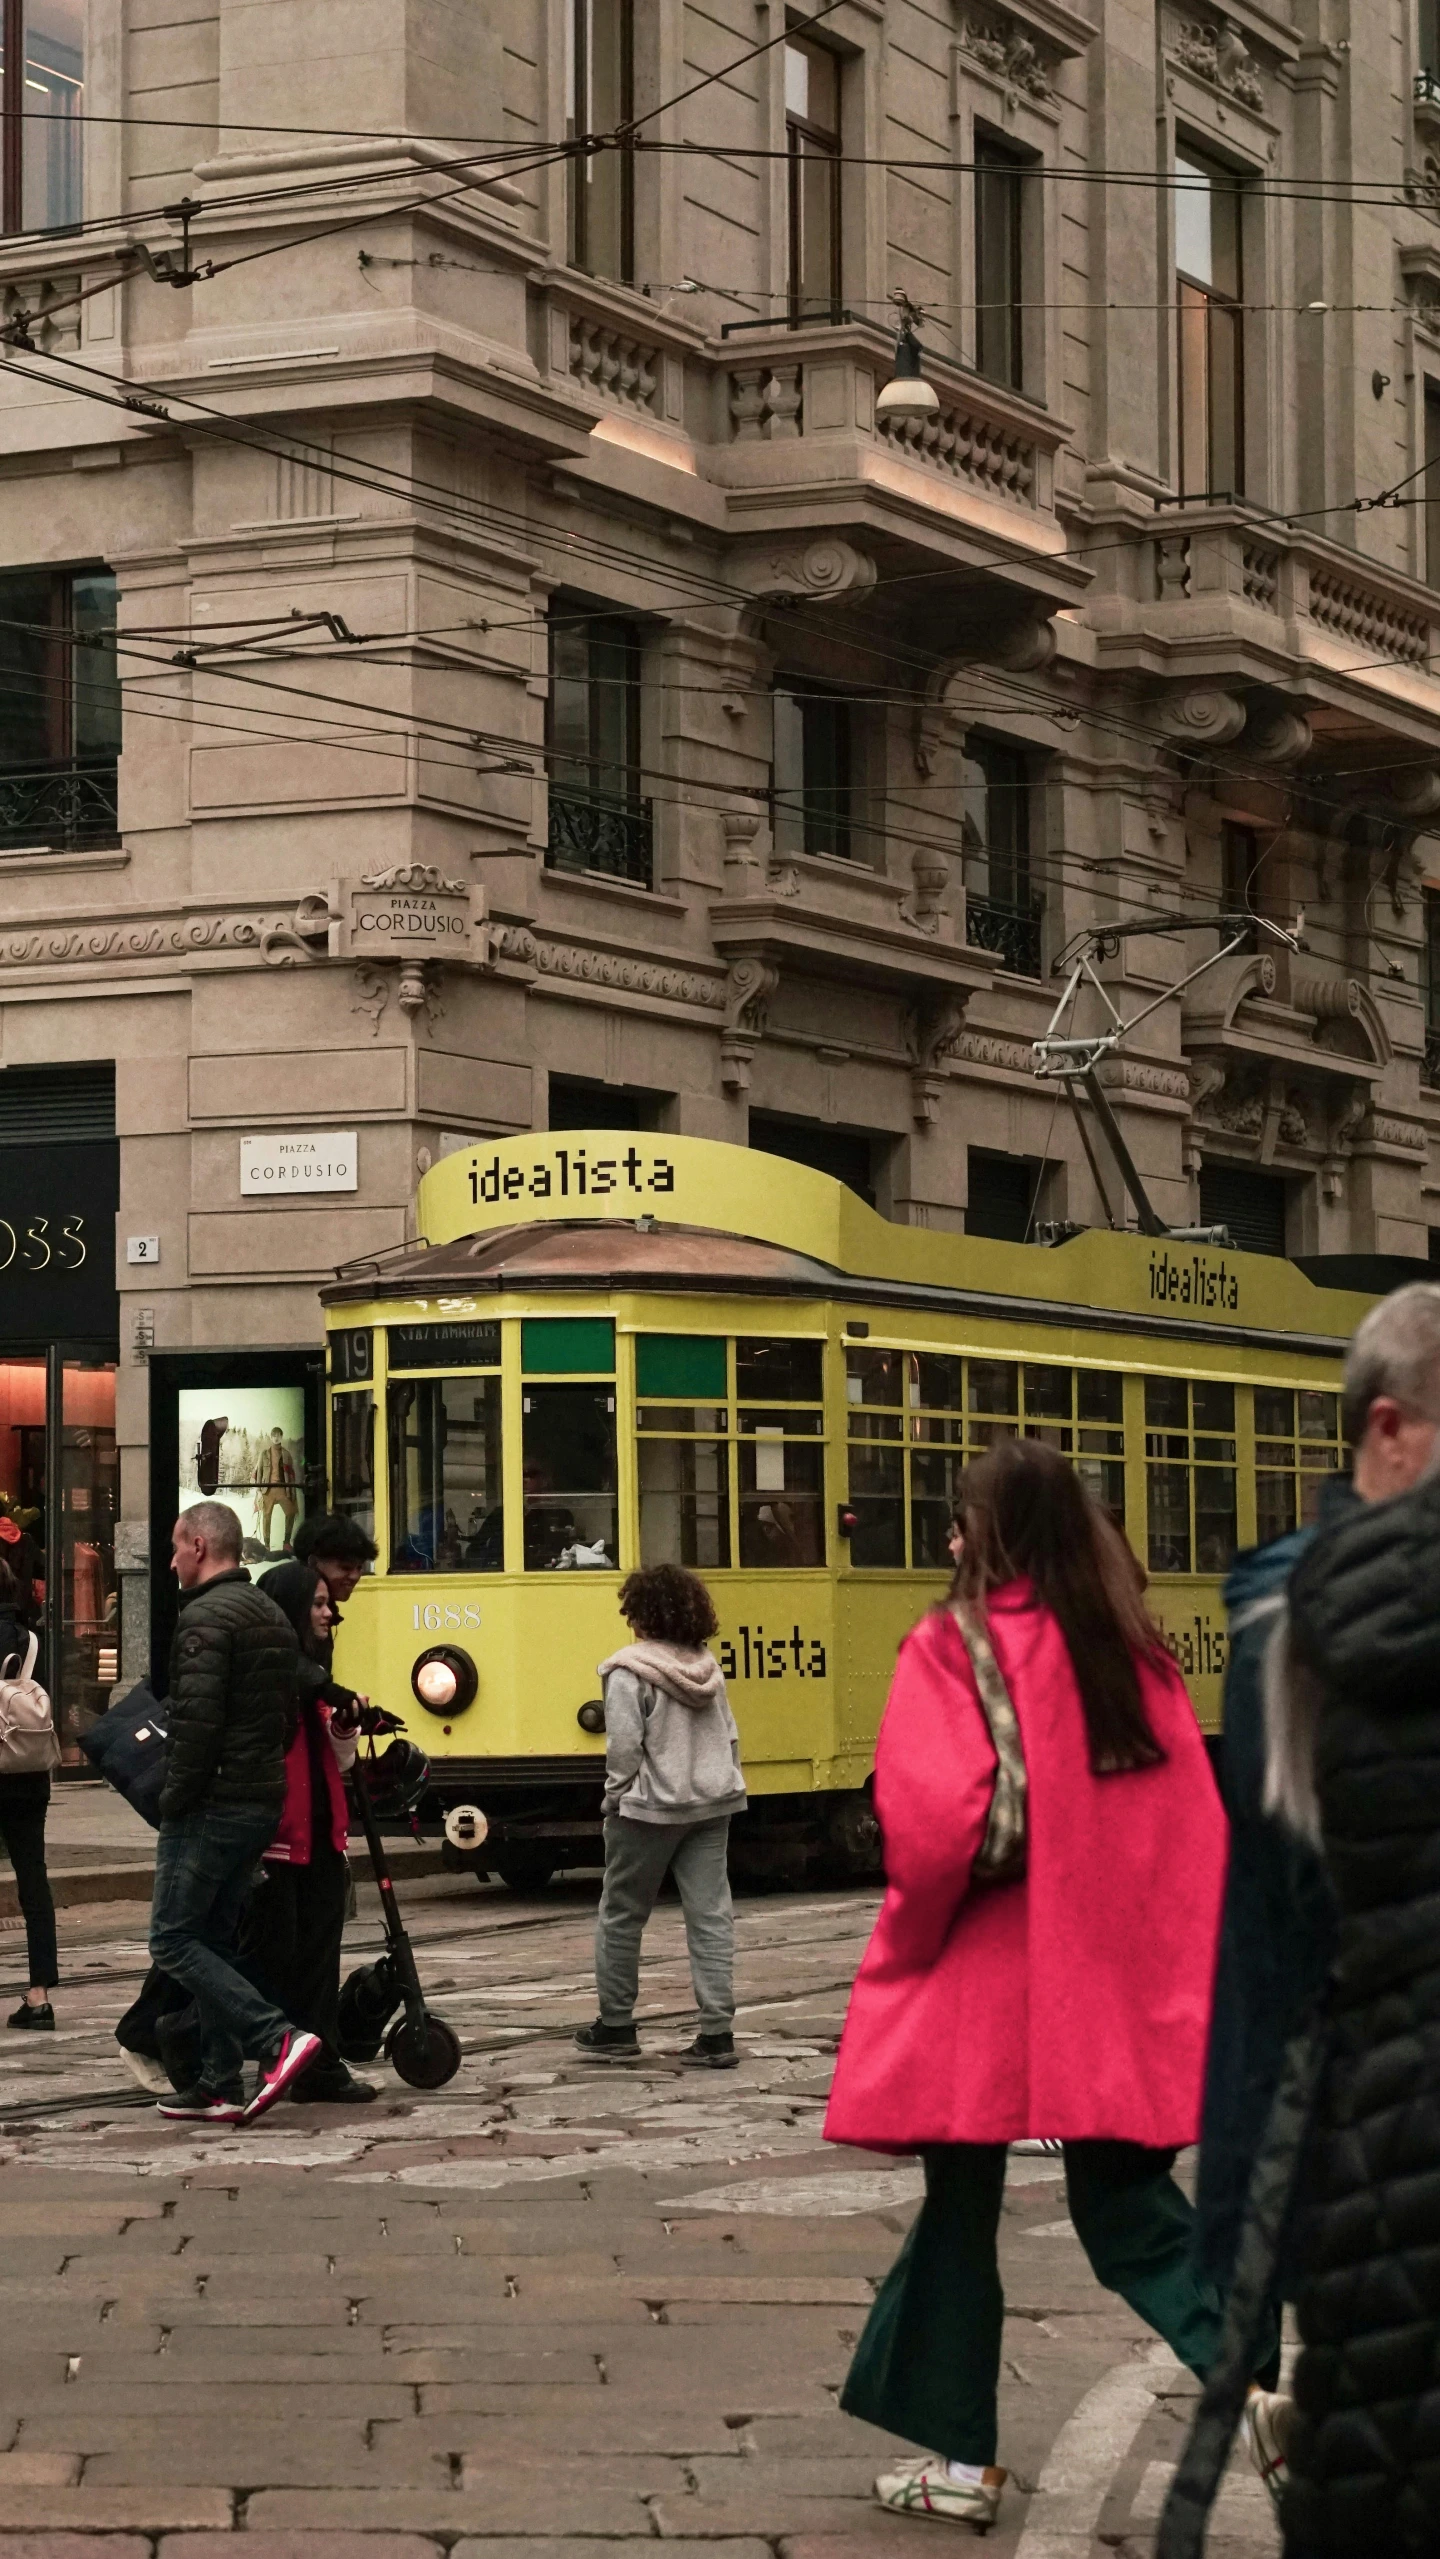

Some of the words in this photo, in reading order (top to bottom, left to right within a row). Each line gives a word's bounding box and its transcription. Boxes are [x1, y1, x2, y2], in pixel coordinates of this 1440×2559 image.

[391, 899, 437, 911] PIAZZA
[359, 913, 464, 934] CORDUSIO
[279, 1144, 316, 1154] PIAZZA
[250, 1163, 347, 1180] CORDUSIO
[468, 1147, 674, 1204] idealista
[0, 1214, 86, 1270] SS
[138, 1241, 147, 1257] 2
[1149, 1250, 1238, 1310] idealista
[344, 1330, 369, 1379] 19
[412, 1603, 482, 1630] 1688
[703, 1625, 826, 1680] alista
